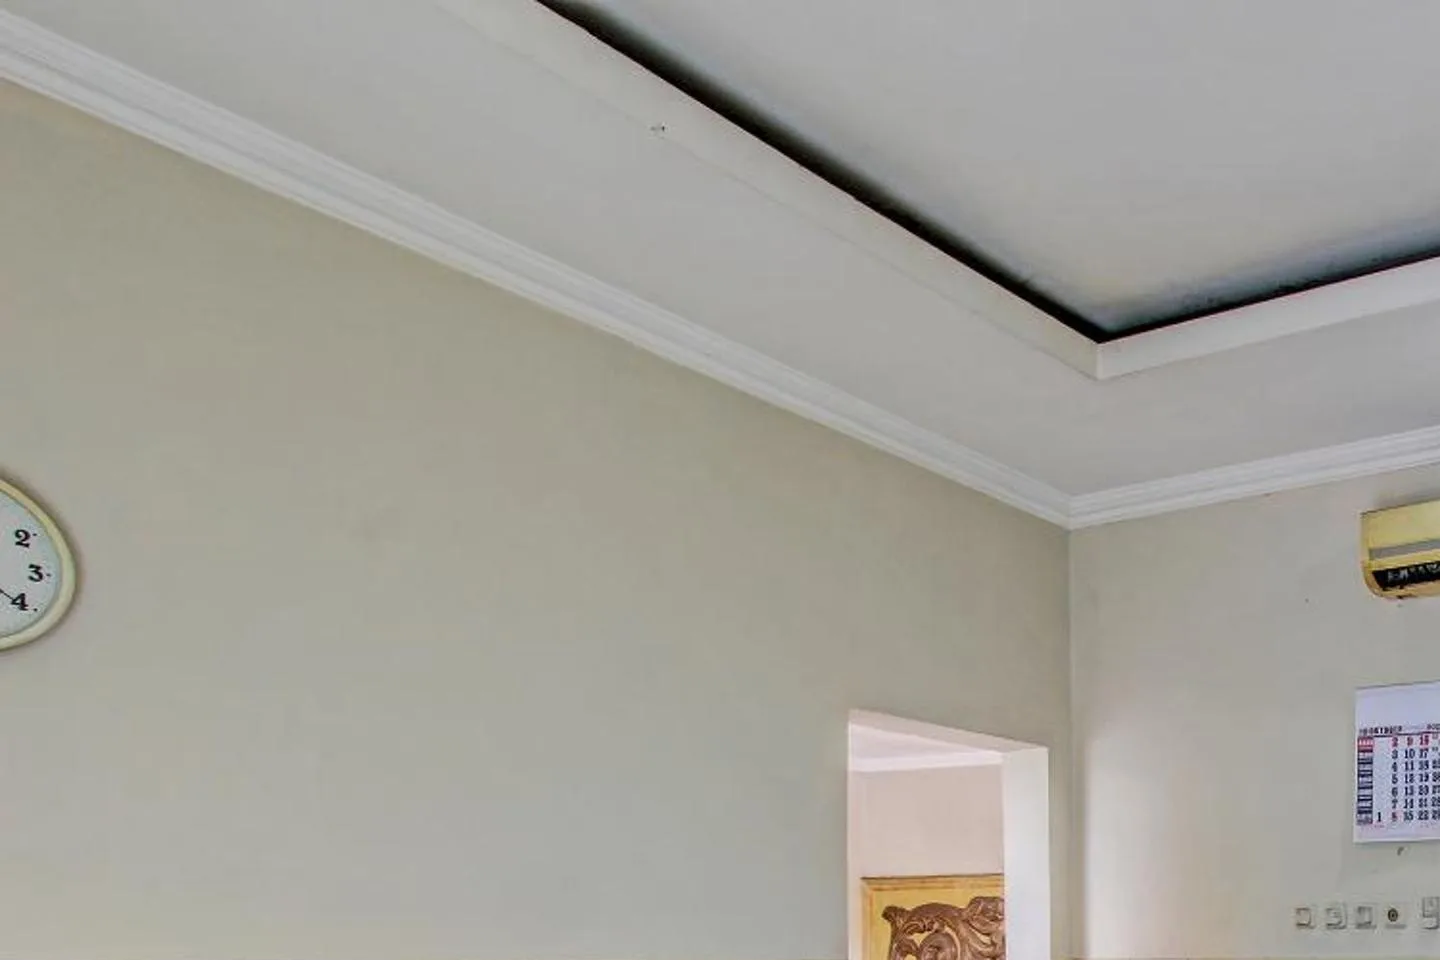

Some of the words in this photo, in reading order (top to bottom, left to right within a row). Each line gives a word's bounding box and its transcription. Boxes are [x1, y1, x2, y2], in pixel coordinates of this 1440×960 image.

[14, 529, 31, 548] 2
[28, 564, 44, 582] 3
[11, 593, 29, 611] 4
